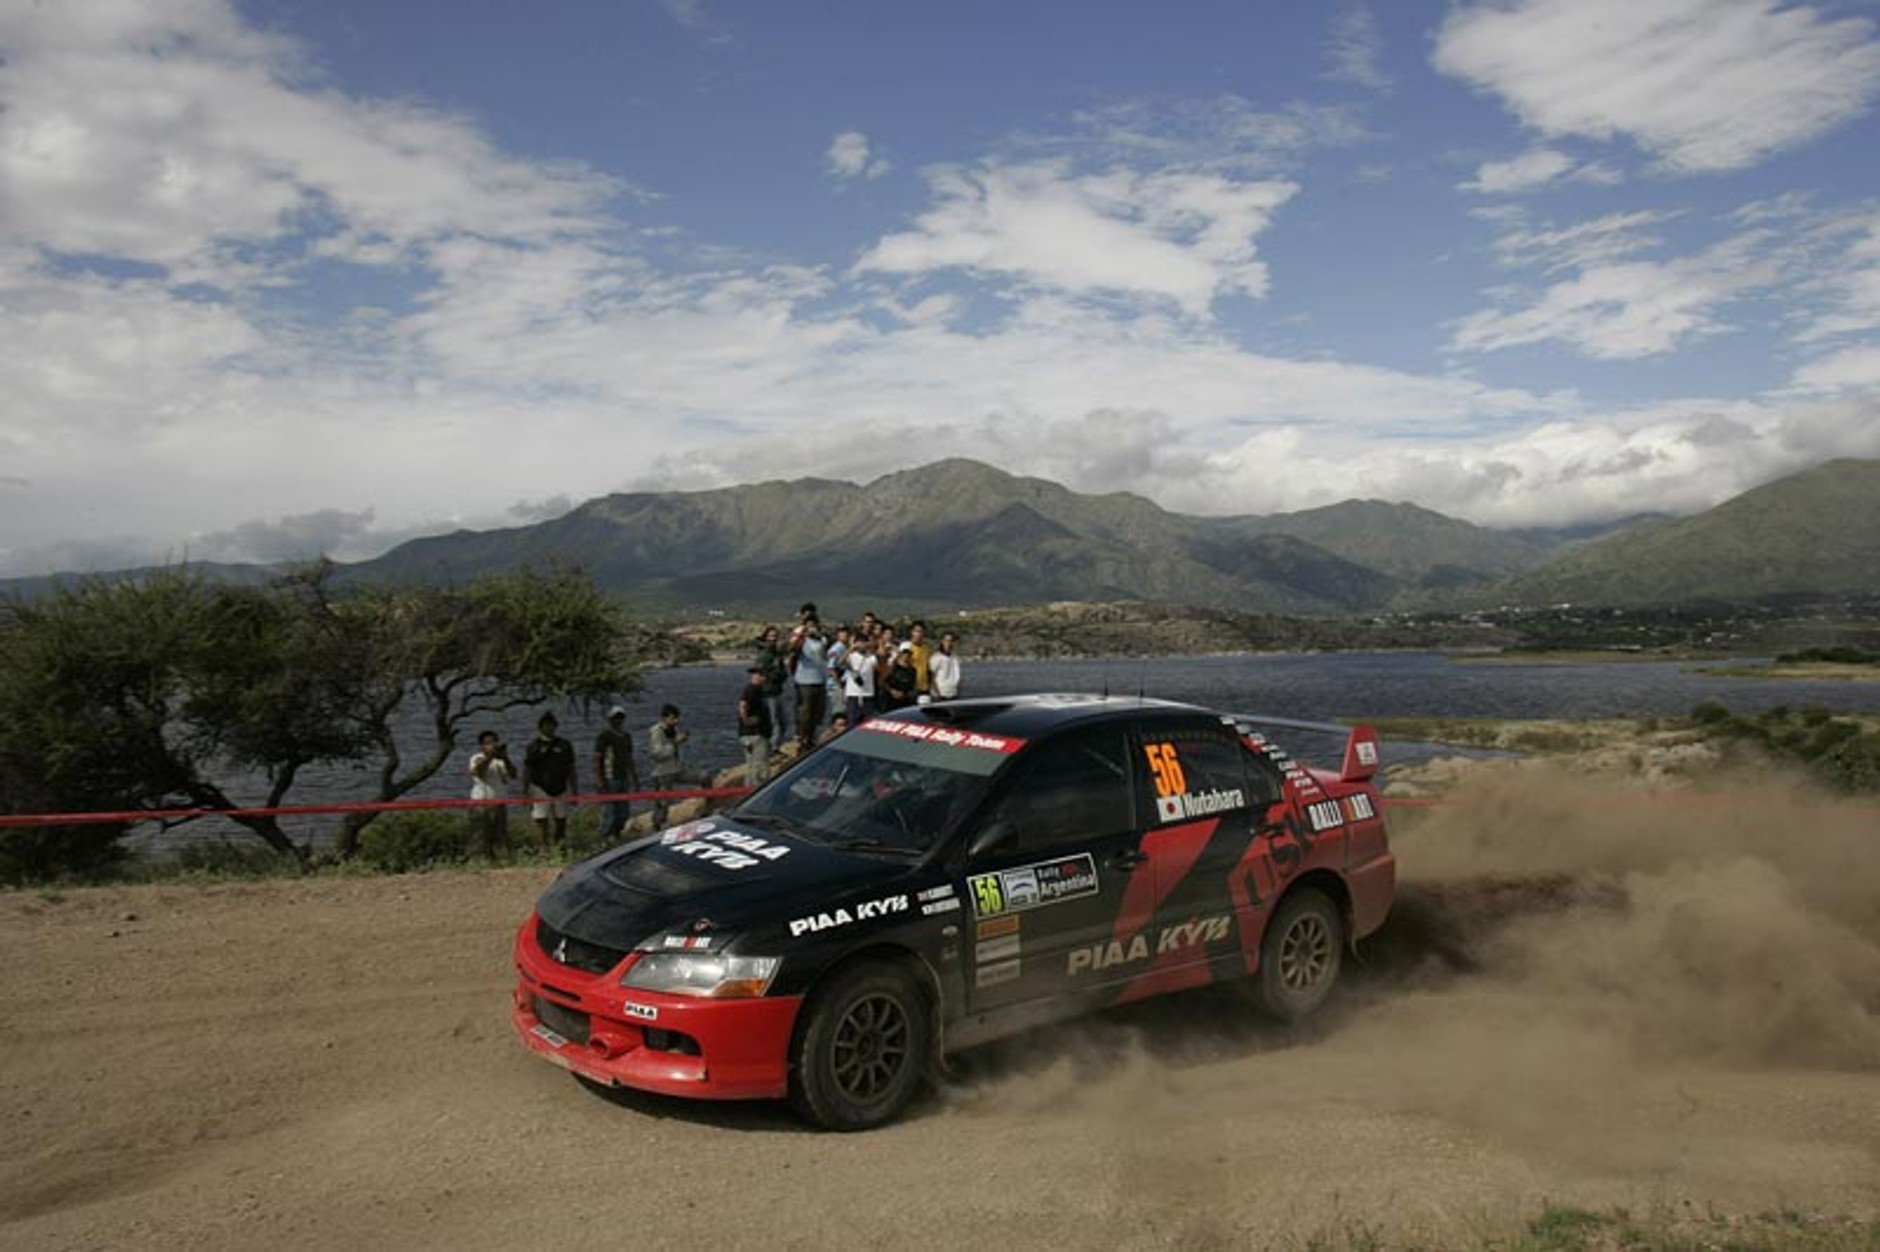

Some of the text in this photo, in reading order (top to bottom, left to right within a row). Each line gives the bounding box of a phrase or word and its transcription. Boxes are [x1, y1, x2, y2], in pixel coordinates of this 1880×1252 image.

[1144, 742, 1186, 797] 56
[670, 840, 760, 870] KYB
[703, 830, 791, 860] PIAA
[975, 873, 1003, 914] 56
[1041, 873, 1095, 897] Argentina
[789, 908, 854, 937] PIAA
[856, 894, 909, 920] KYB
[1066, 935, 1149, 976] PIAA
[1156, 915, 1231, 953] KYB
